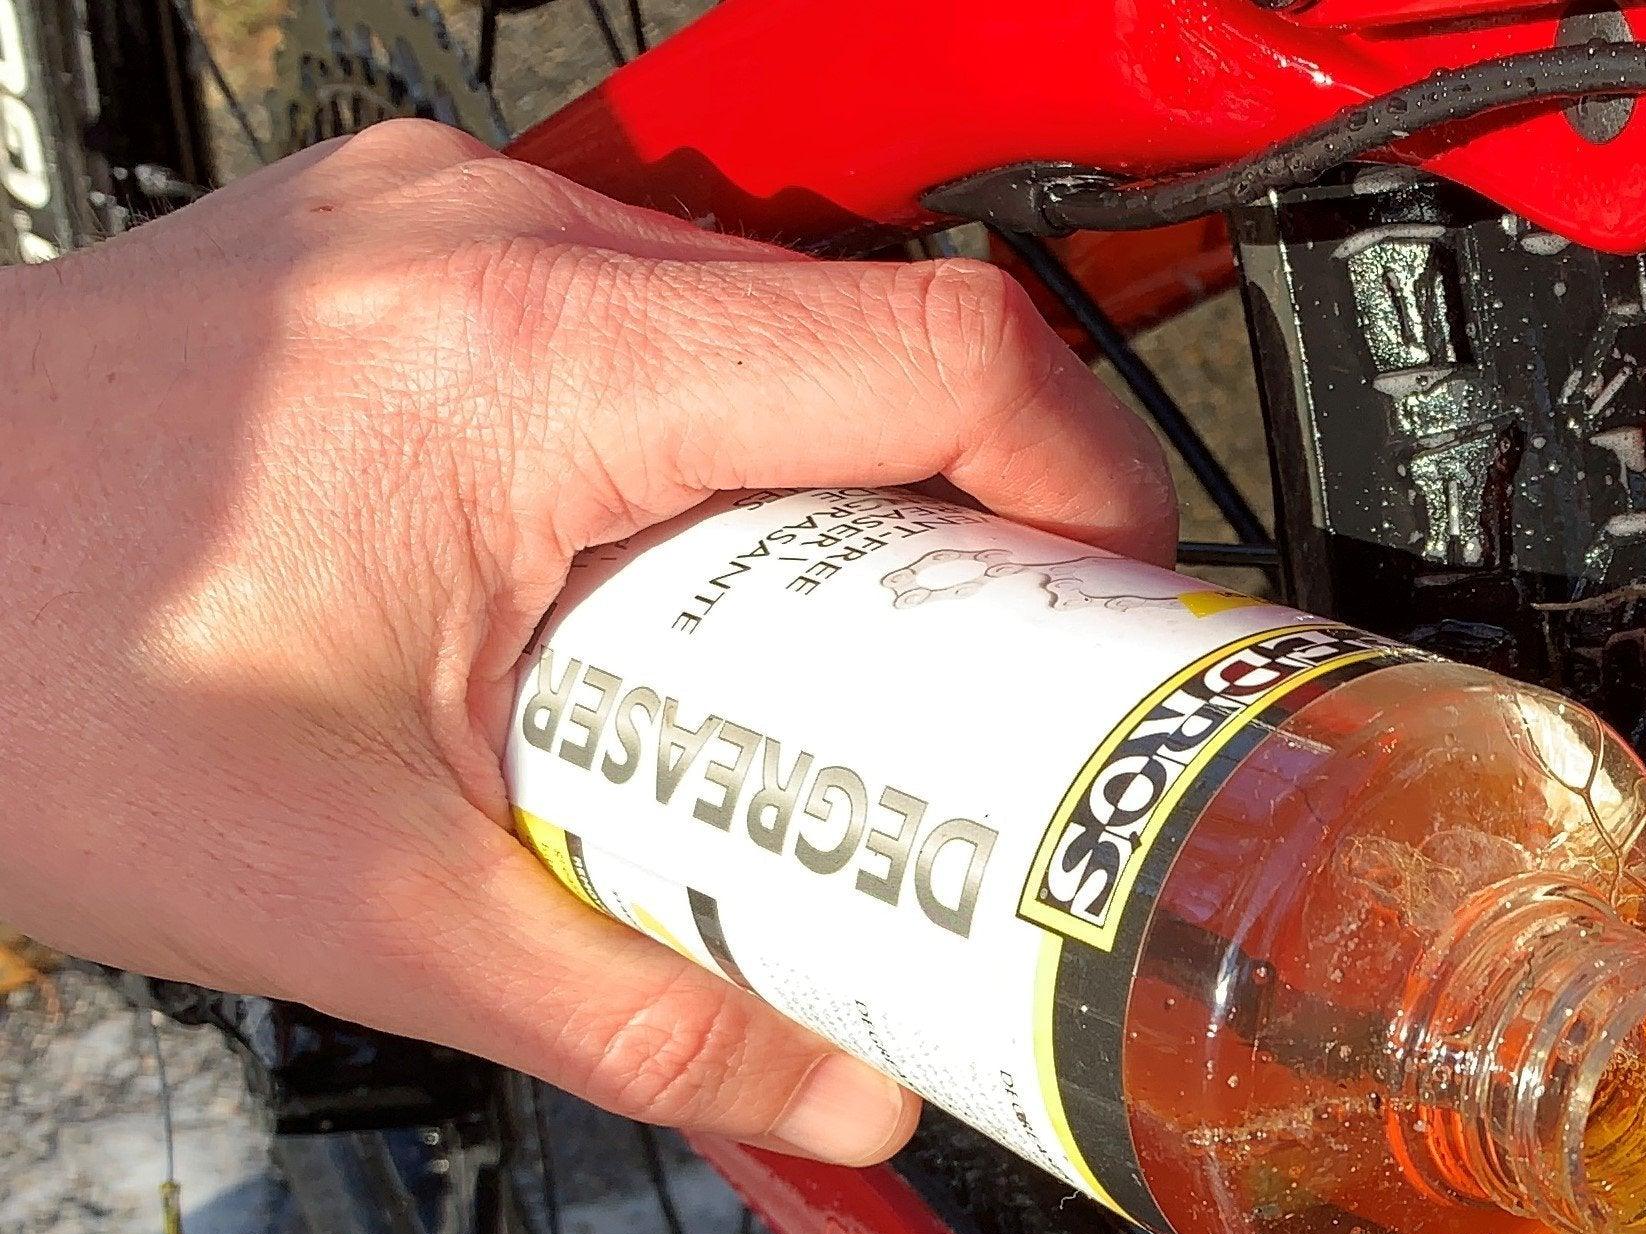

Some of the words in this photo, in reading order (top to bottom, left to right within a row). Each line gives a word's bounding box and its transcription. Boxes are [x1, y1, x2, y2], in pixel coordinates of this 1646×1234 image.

[670, 496, 890, 635] GRASANTE
[785, 509, 986, 596] ENT-FREE
[520, 644, 1001, 940] DEGREASER
